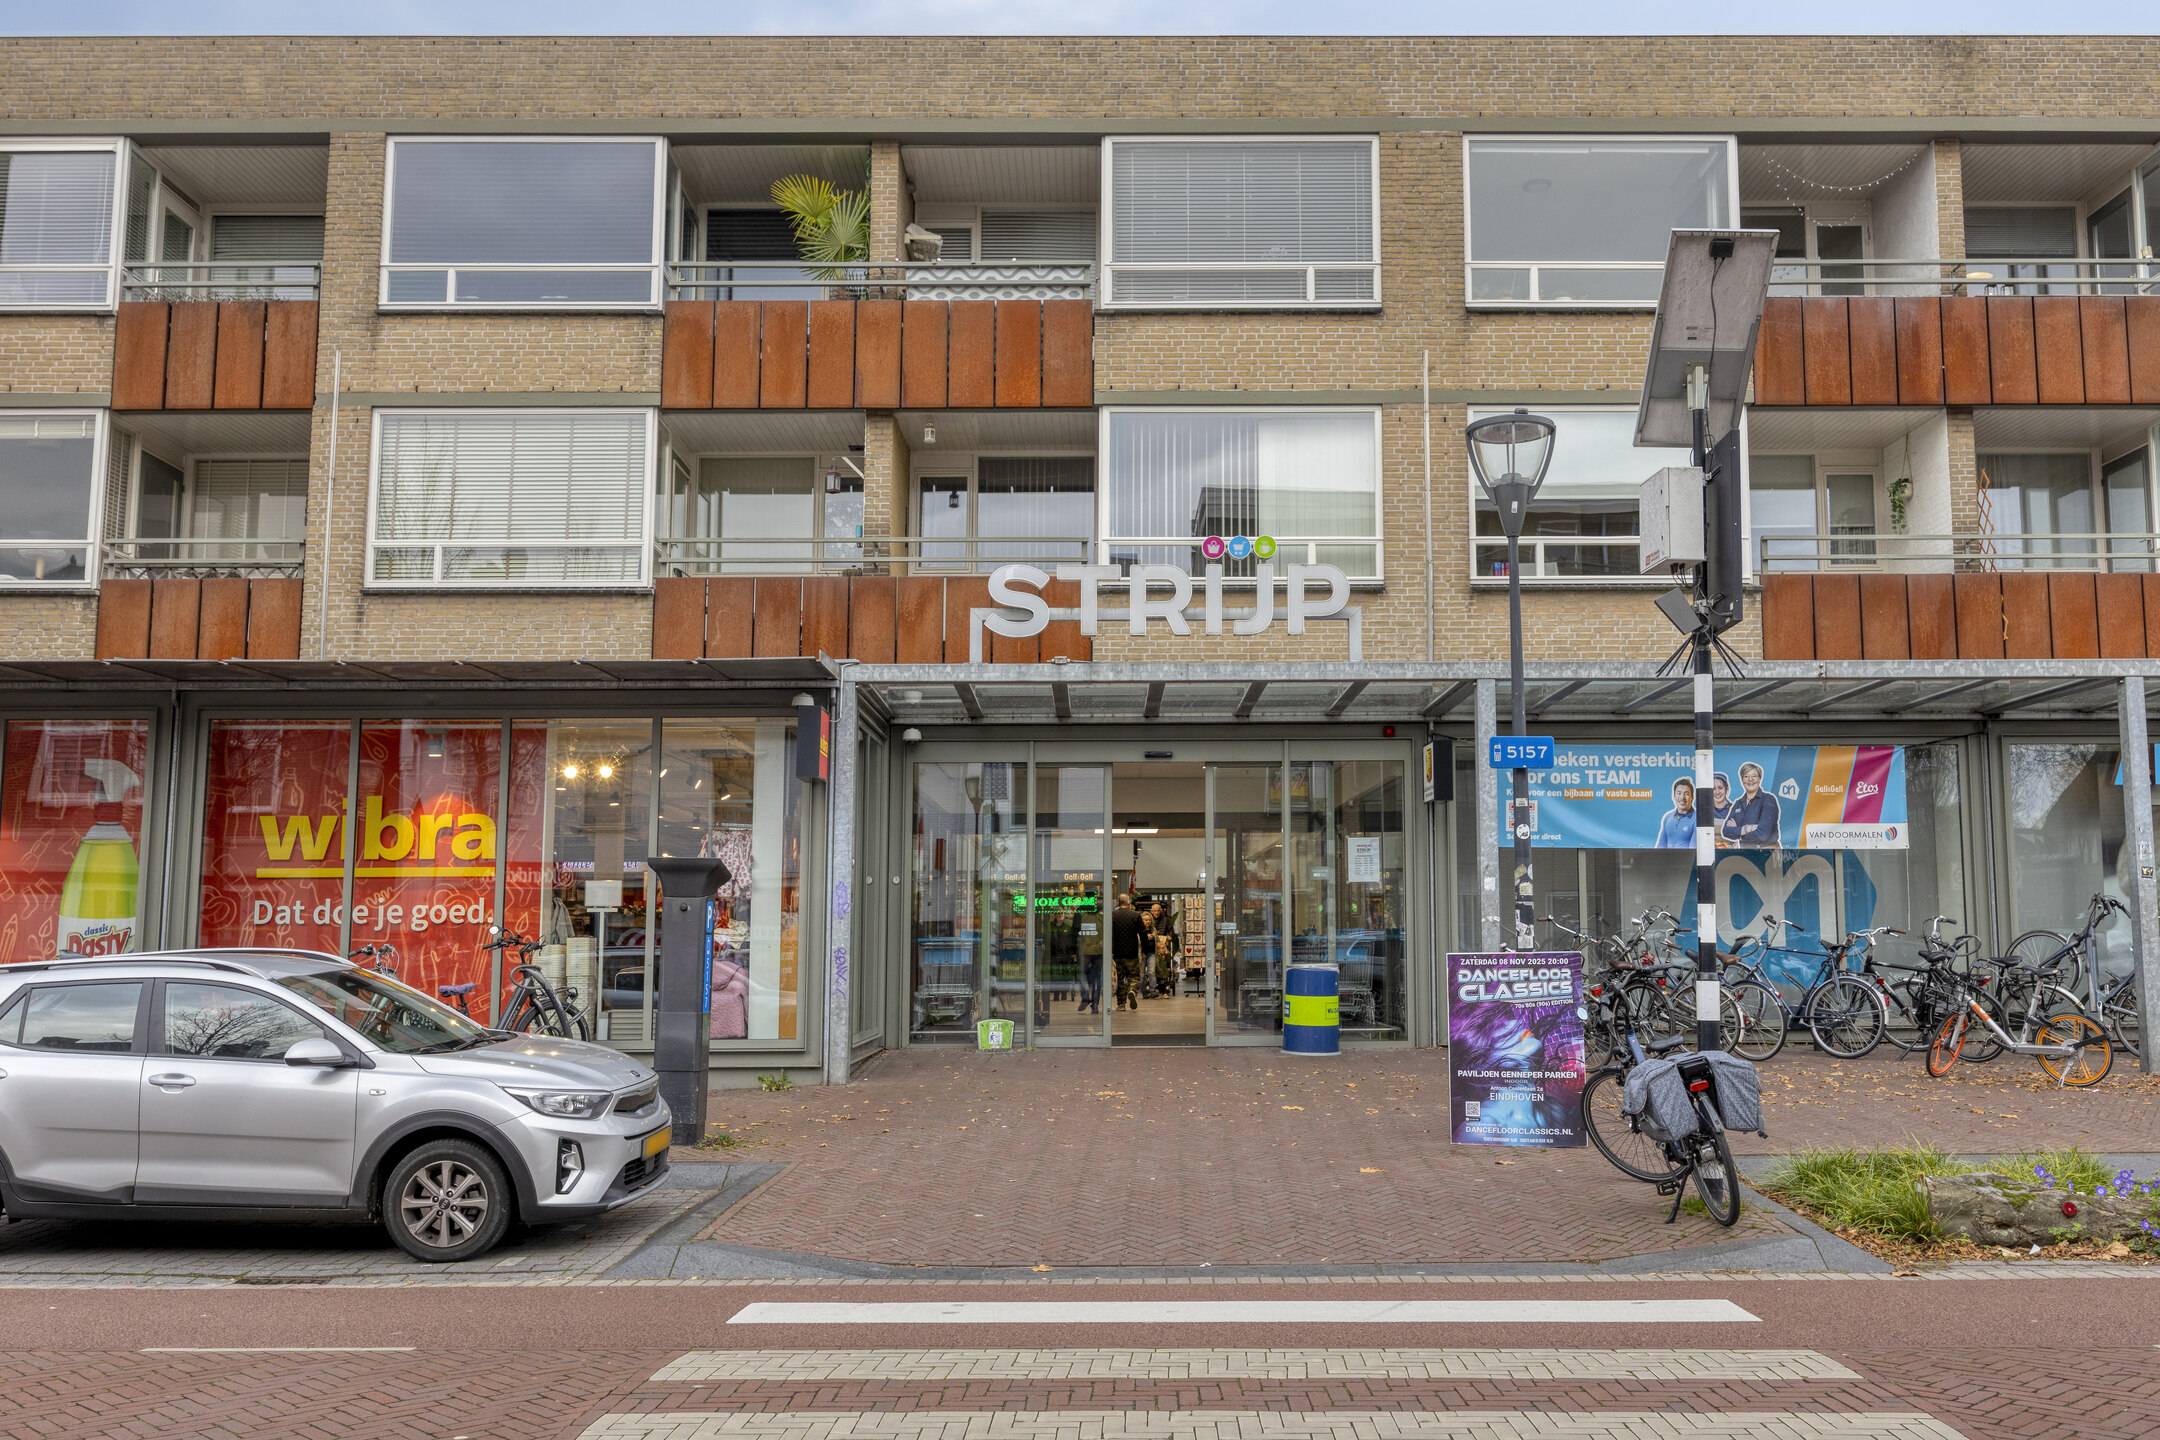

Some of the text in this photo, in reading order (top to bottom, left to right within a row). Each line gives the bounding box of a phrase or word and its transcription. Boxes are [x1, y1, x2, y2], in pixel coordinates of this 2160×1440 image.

[983, 563, 1351, 638] STRIJP
[1507, 745, 1548, 759] 5157
[1506, 769, 1640, 784] vor ons TEAM!
[1564, 788, 1594, 799] bijbaan
[1595, 788, 1604, 797] of
[1605, 790, 1629, 798] vaste
[1630, 789, 1653, 798] baan!
[1856, 781, 1879, 795] Etos
[1541, 832, 1562, 841] direct
[1809, 831, 1883, 839] VAN DOORMALEN
[253, 899, 305, 926] Dat
[373, 897, 404, 932] je
[410, 897, 494, 932] goed.
[84, 923, 109, 936] classic
[1460, 957, 1497, 966] ZATERDAG
[1527, 957, 1546, 965] 2025
[1547, 957, 1569, 965] 20:00
[1458, 968, 1572, 983] DANCEFLOOR
[1459, 980, 1573, 1002] CLASSICS
[1457, 1070, 1578, 1079] PAVILJOEN GENNEPER PARKEN
[1490, 1092, 1545, 1102] EINDHOVEN
[1465, 1126, 1574, 1136] DANCEFLOORCLASSICS.NL
